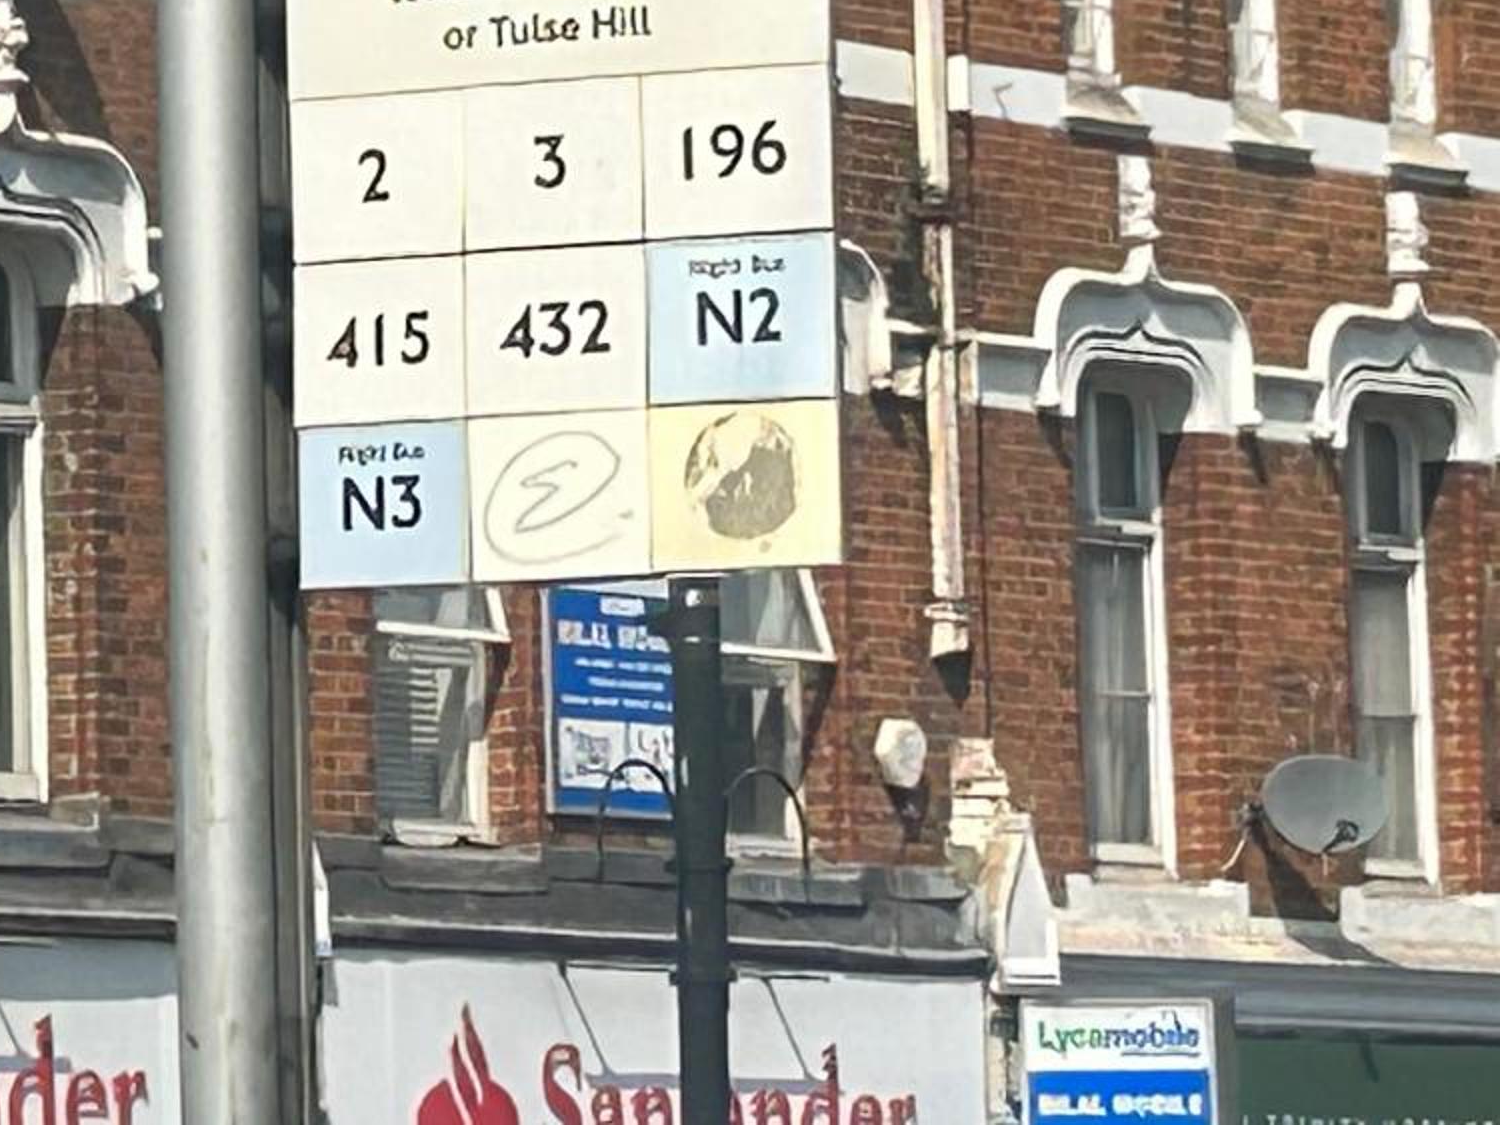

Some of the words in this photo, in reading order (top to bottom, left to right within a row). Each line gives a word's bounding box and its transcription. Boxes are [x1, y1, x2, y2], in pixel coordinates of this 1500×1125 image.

[443, 25, 478, 51] or
[488, 13, 581, 48] Tulse
[591, 5, 652, 40] Hill
[357, 148, 390, 203] 2
[532, 134, 567, 189] 3
[682, 119, 788, 181] 196
[325, 310, 431, 370] 415
[499, 299, 612, 359] 432
[696, 286, 782, 347] N2
[342, 474, 423, 532] N3
[542, 1042, 918, 1125] Sannder
